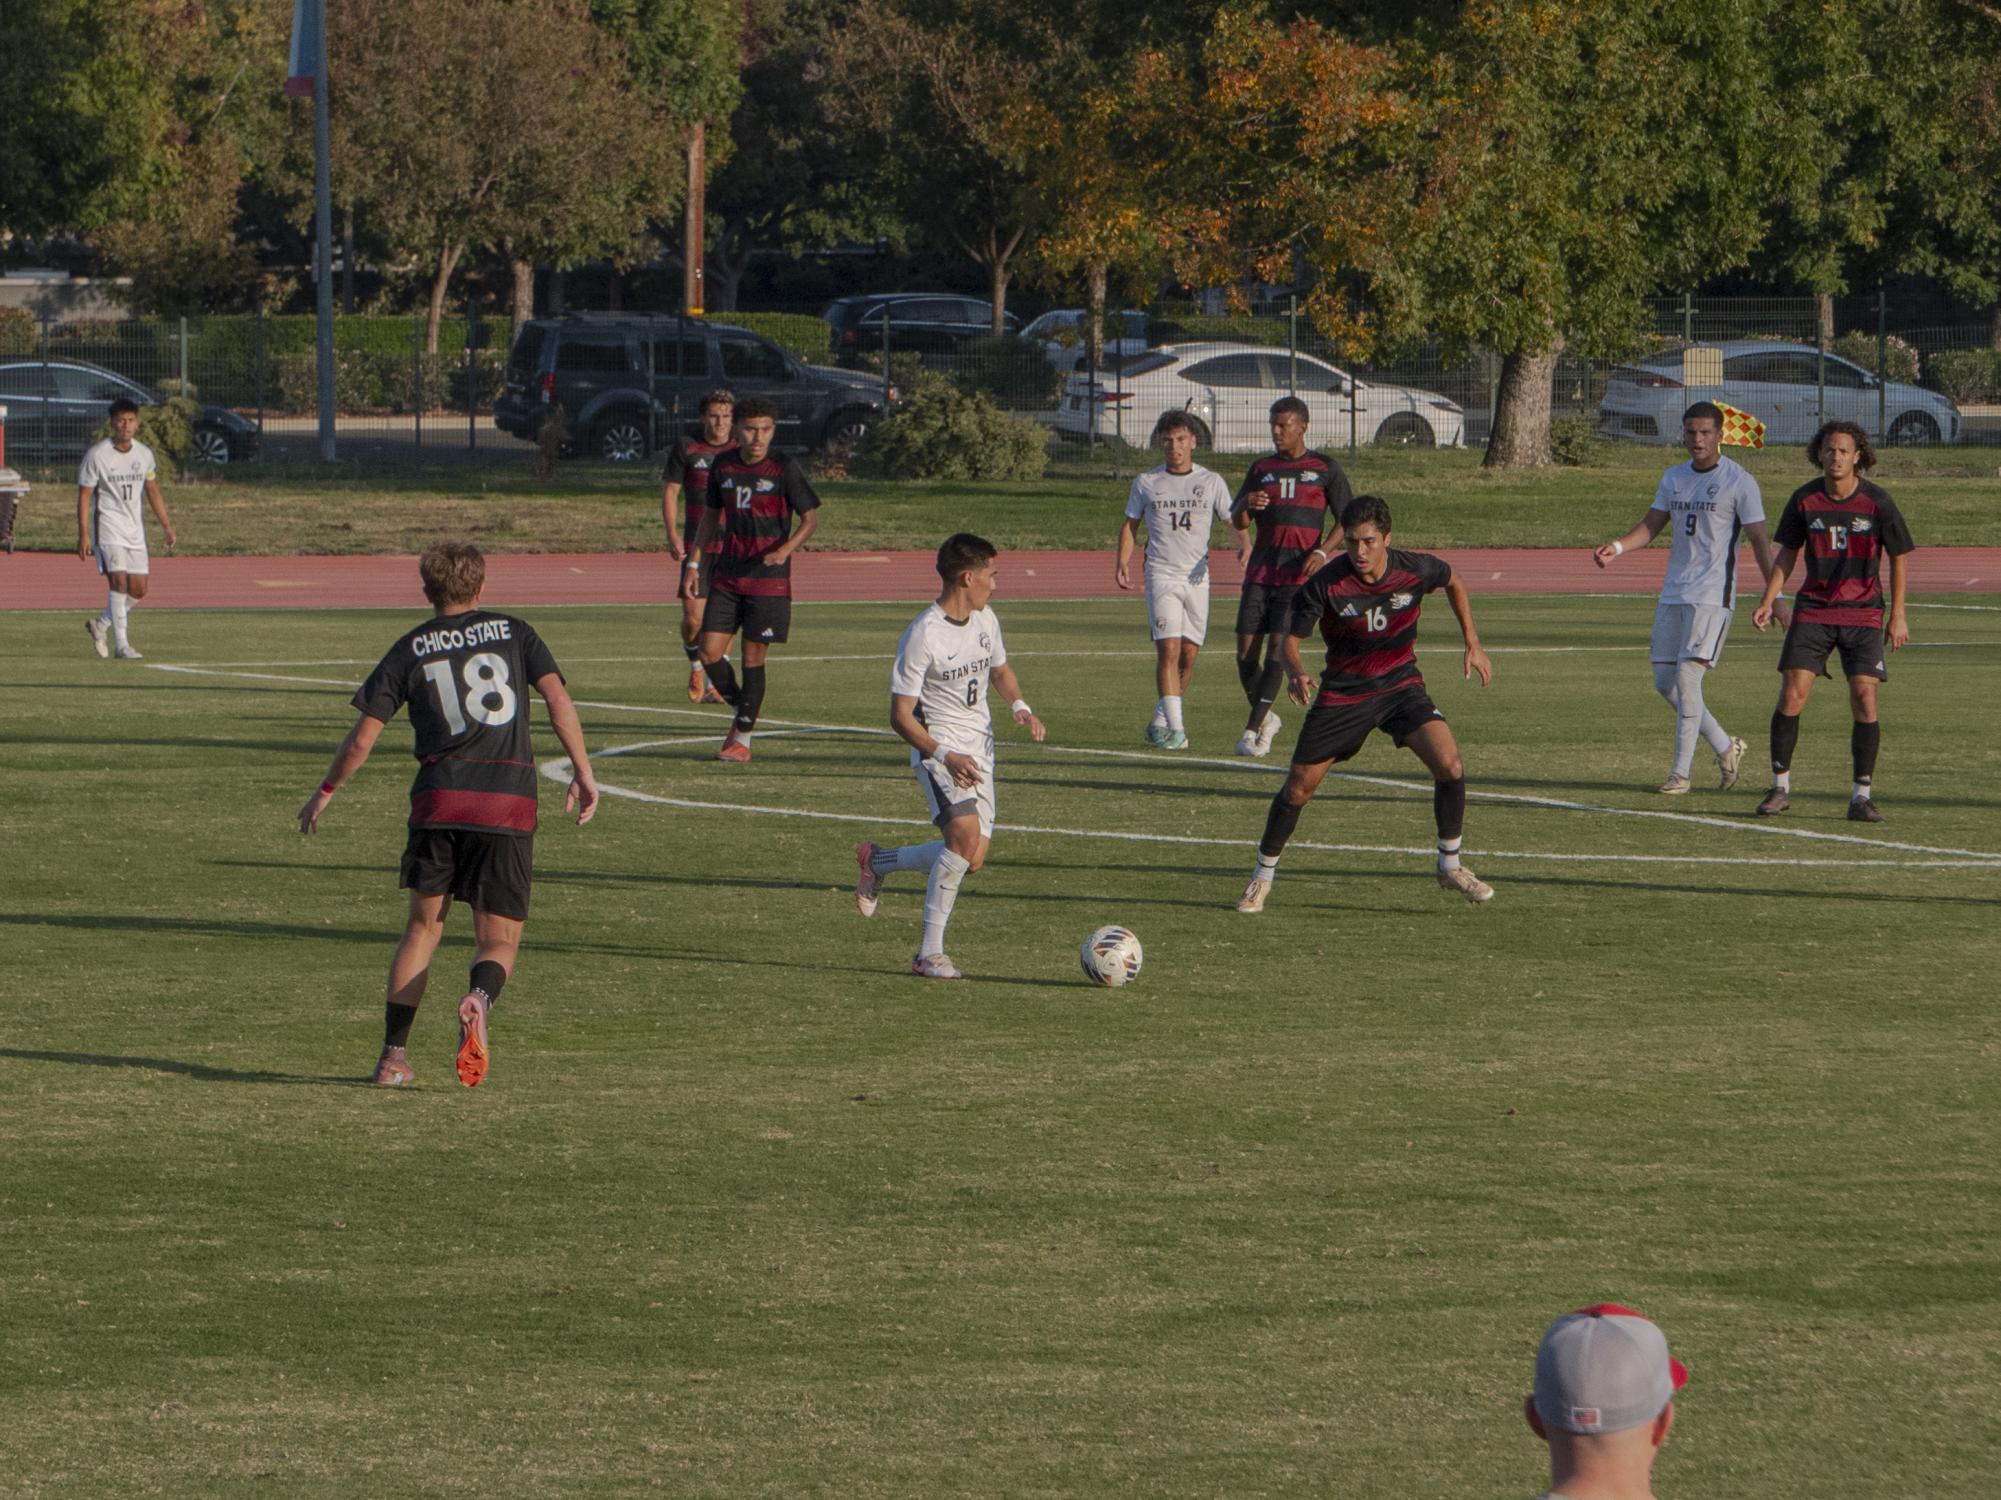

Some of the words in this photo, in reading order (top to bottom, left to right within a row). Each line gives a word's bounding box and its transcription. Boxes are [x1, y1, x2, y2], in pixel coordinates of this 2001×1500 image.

[121, 484, 133, 501] 17
[736, 486, 752, 509] 12
[1279, 478, 1296, 499] 11
[1151, 501, 1177, 510] STAN
[1169, 511, 1192, 531] 14
[1685, 513, 1697, 536] 9
[1829, 526, 1848, 550] 13
[1365, 606, 1388, 632] 16
[412, 630, 464, 657] CHICO
[464, 620, 512, 647] STATE
[942, 663, 969, 681] STAN
[423, 652, 517, 736] 18
[967, 678, 978, 707] 6
